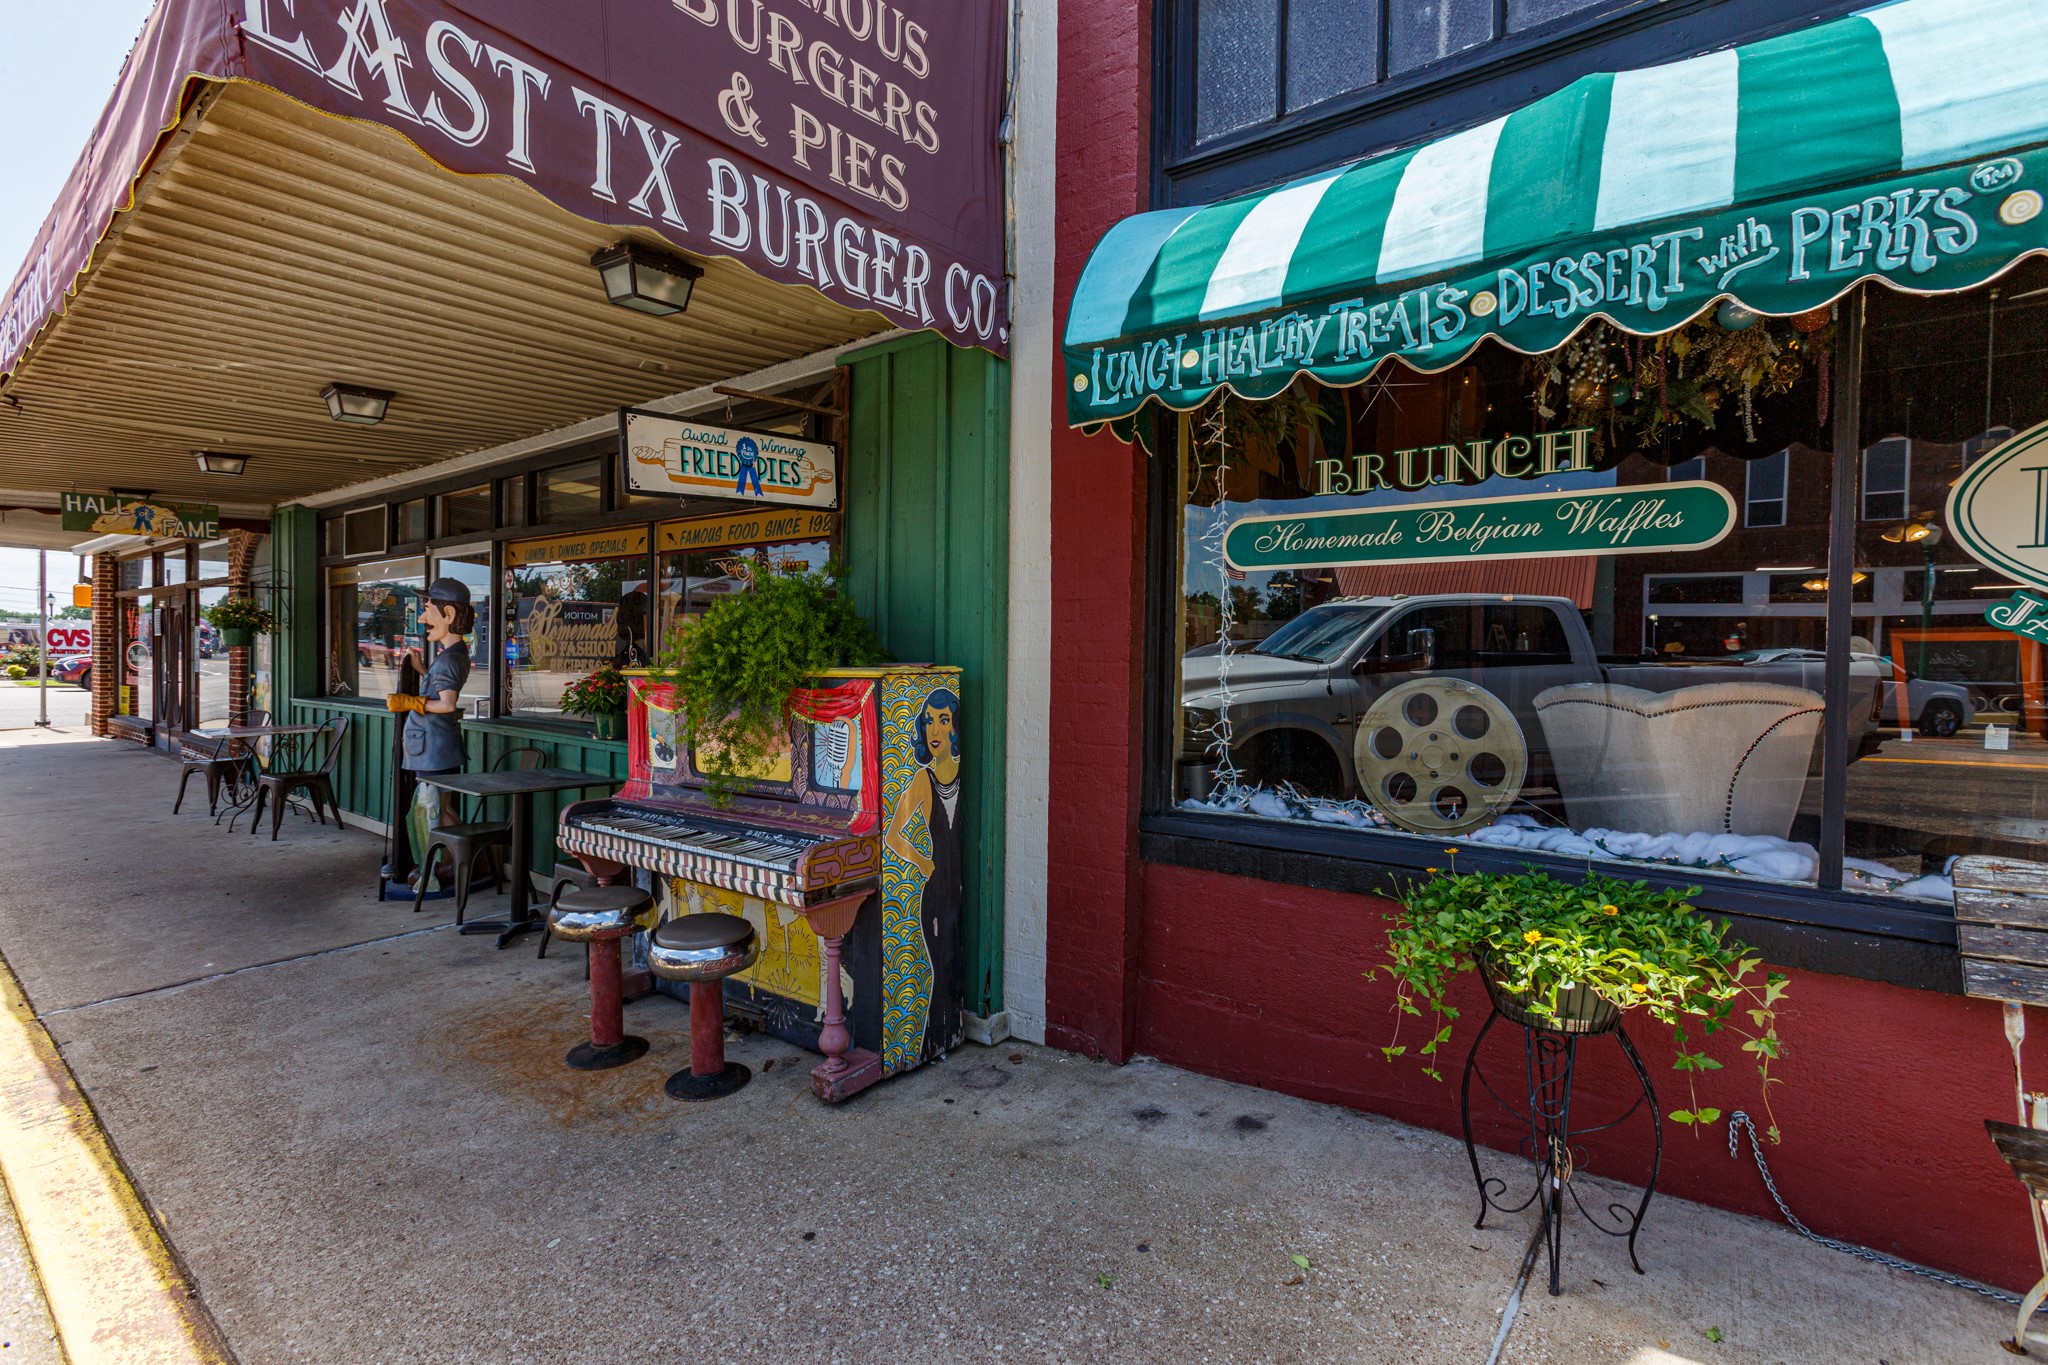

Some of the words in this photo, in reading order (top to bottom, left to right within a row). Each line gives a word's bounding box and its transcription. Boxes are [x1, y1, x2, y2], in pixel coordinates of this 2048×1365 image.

[798, 0, 930, 79] OUS
[717, 71, 768, 147] &
[789, 104, 910, 212] PIES
[570, 85, 689, 232] TX
[706, 157, 936, 326] BURGER
[944, 262, 1008, 344] CO.
[1088, 333, 1183, 407] LUNCH
[1200, 310, 1331, 386] HEALTHY
[1328, 282, 1469, 363] TREATS
[1497, 226, 1704, 327] DESSERT
[1697, 217, 1780, 284] with
[1789, 187, 1979, 284] PERKS
[680, 445, 741, 479] FRIED
[757, 454, 802, 487] PIES
[760, 438, 806, 461] Winning
[1315, 427, 1595, 496] BRUNCH
[66, 495, 132, 517] HALL
[139, 508, 150, 521] of
[162, 518, 219, 539] FAME
[680, 525, 723, 546] FAMOUS
[728, 521, 760, 541] FOOD
[764, 517, 802, 537] SINCE
[1253, 518, 1403, 554] Homemade
[1415, 510, 1544, 553] Belgian
[1555, 498, 1685, 544] Waffles
[524, 549, 546, 561] LUNCH
[550, 548, 554, 559] &
[558, 543, 586, 558] DINNER
[590, 538, 628, 555] SPECIALS
[527, 595, 619, 645] Homemade
[47, 629, 91, 647] CVS
[531, 640, 557, 657] OLD
[560, 640, 617, 657] FASHION
